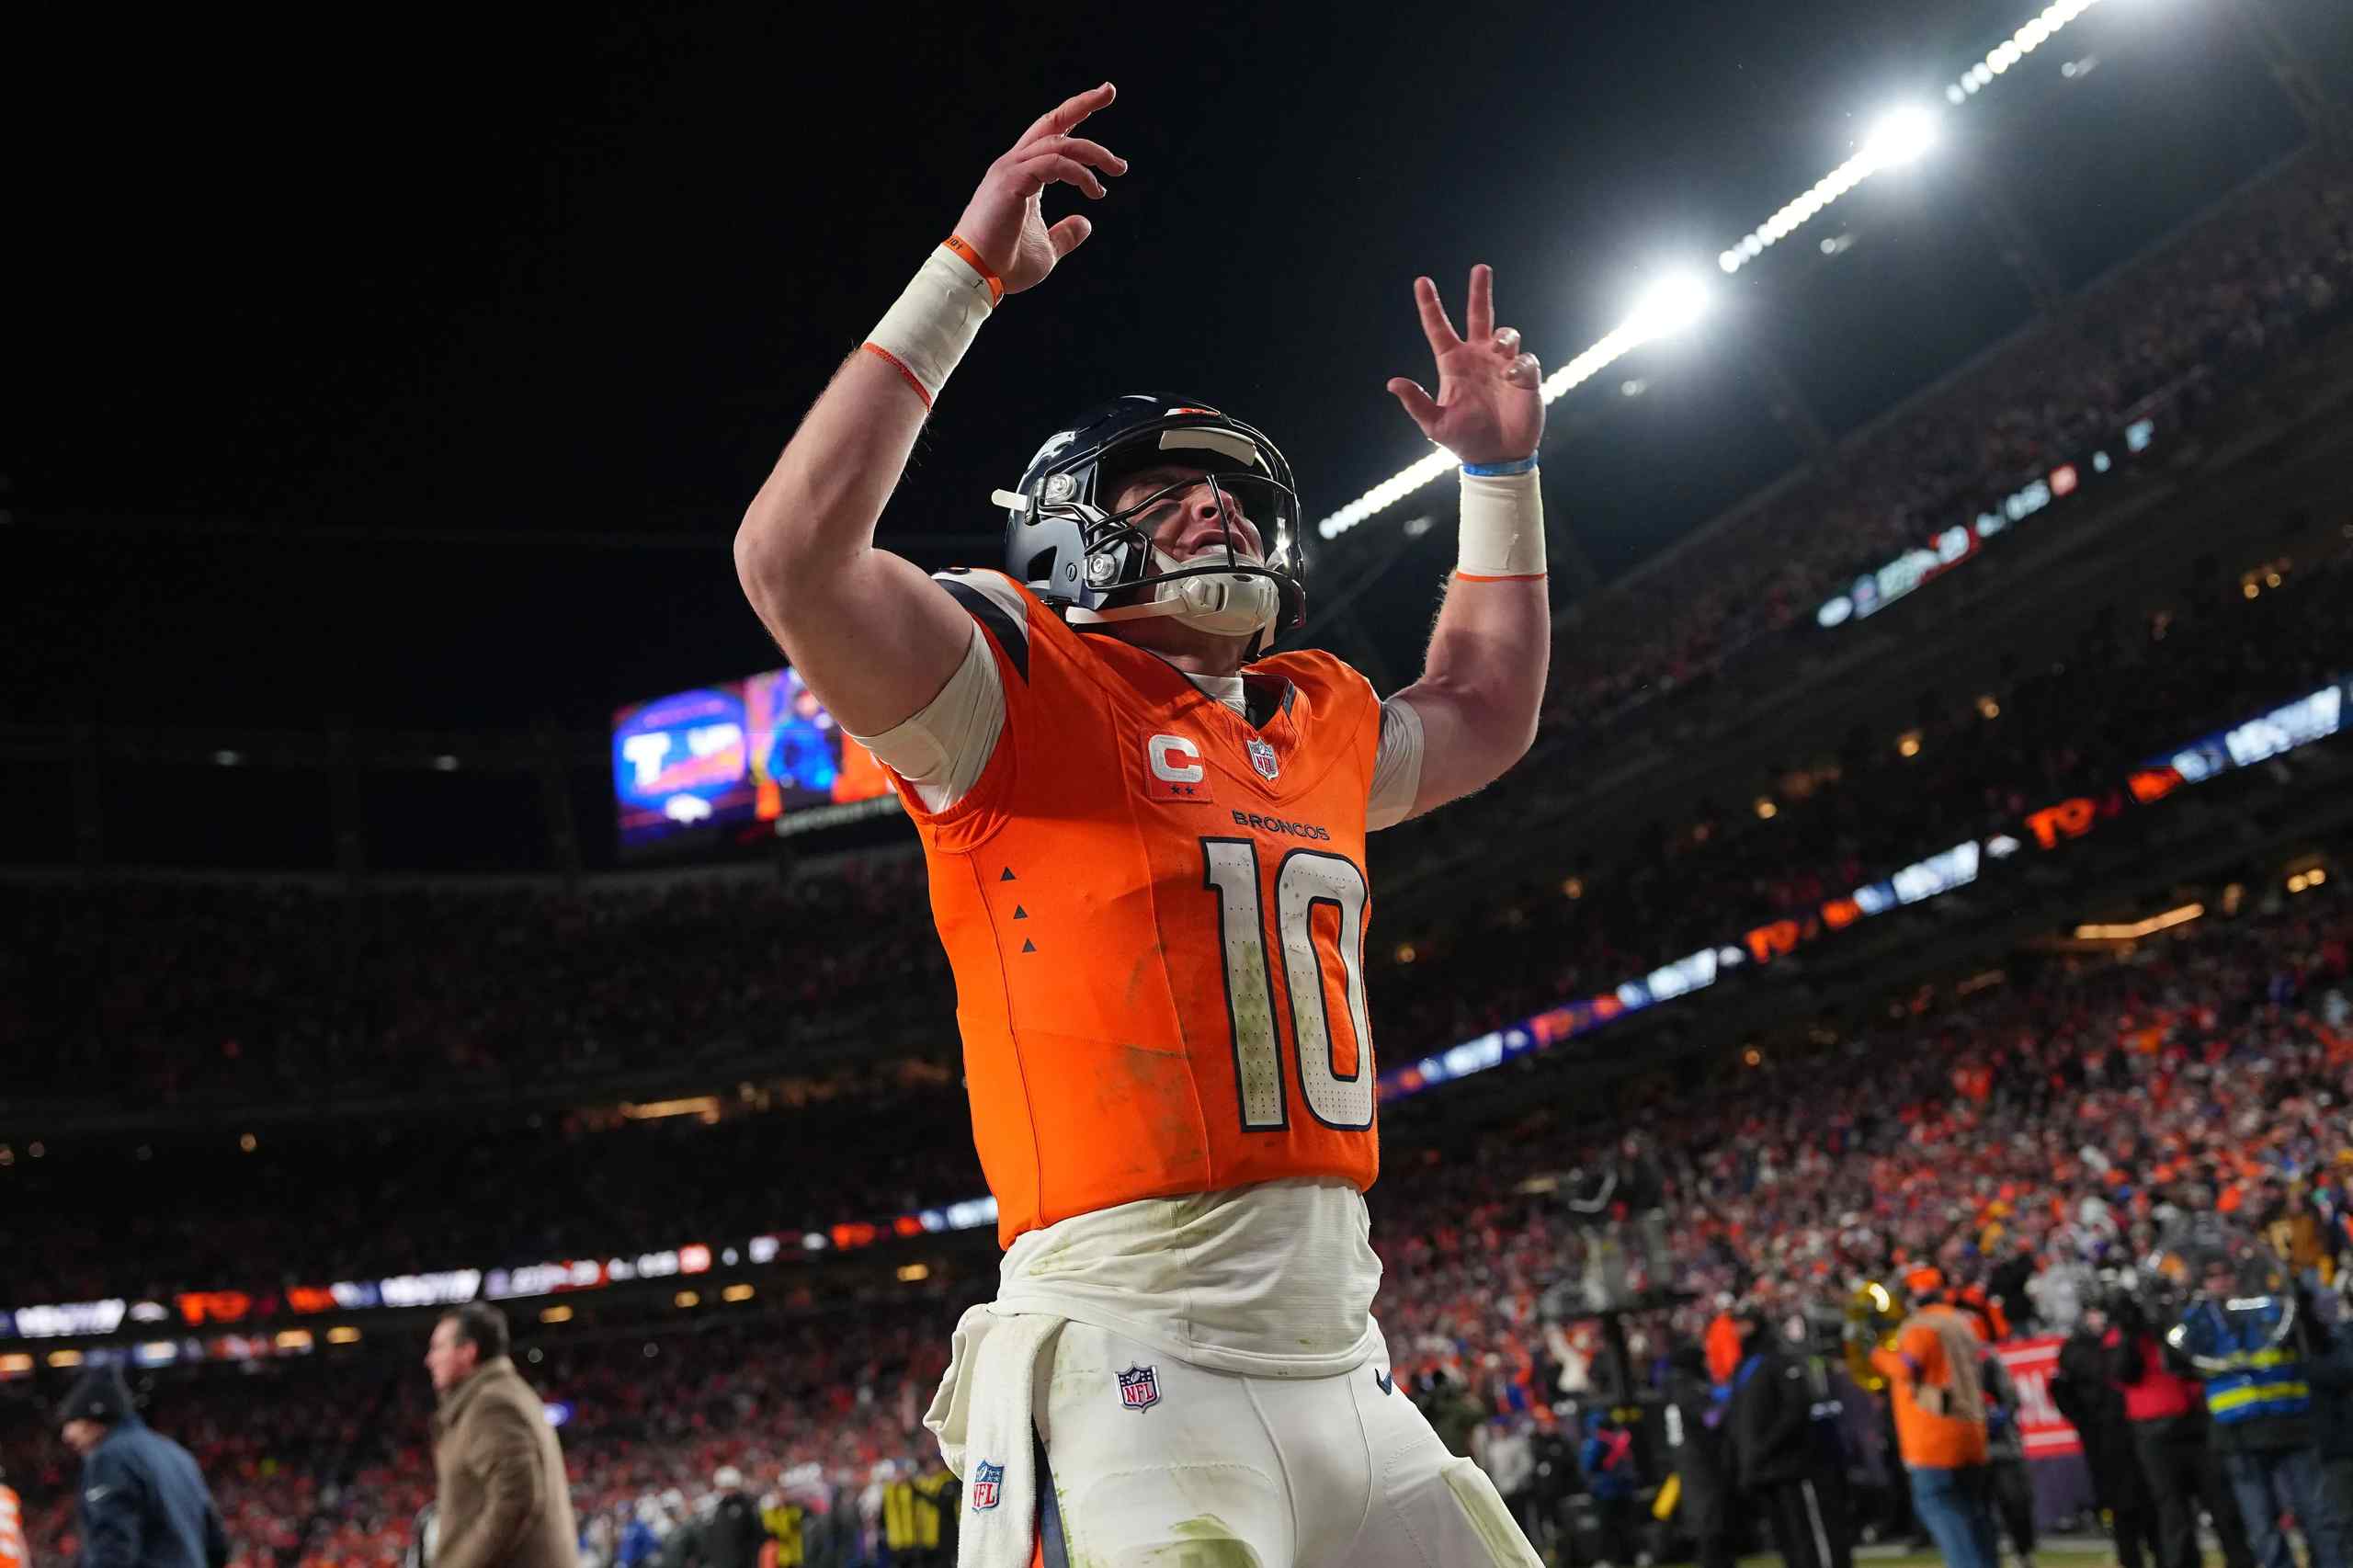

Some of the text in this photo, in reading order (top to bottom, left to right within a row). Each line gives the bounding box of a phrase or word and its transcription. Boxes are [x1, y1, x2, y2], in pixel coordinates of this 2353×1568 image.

[1148, 733, 1204, 783] C
[1232, 809, 1330, 840] BRONCOS
[1200, 837, 1373, 1131] 10
[1124, 1383, 1154, 1403] NFL
